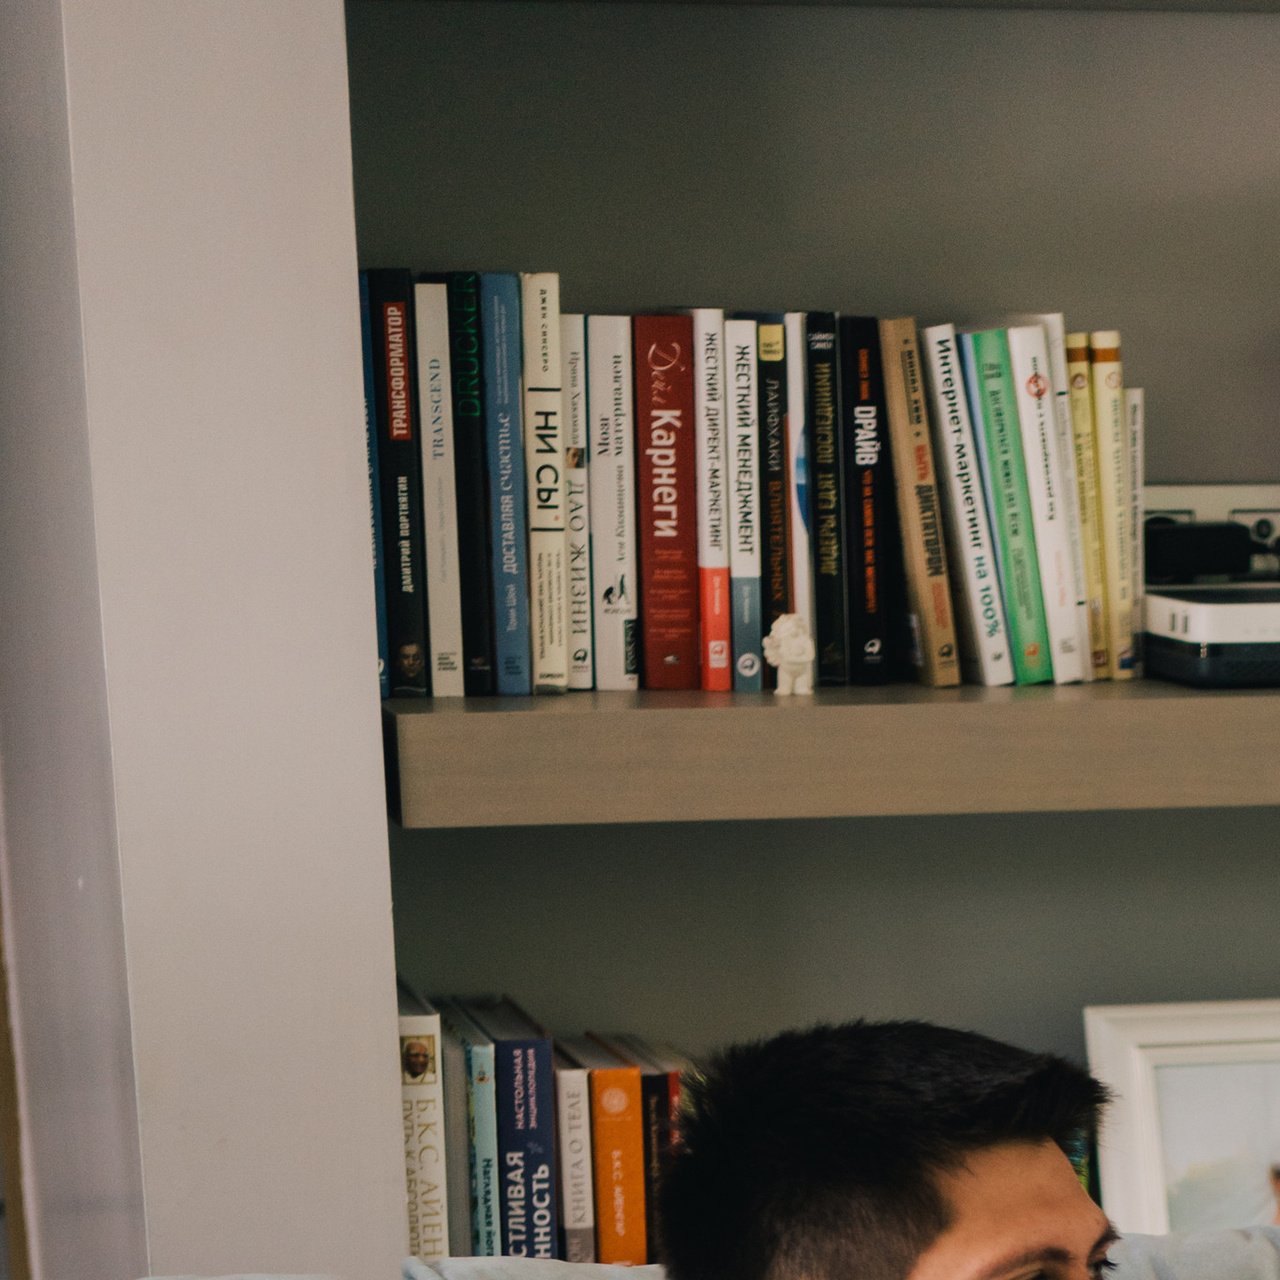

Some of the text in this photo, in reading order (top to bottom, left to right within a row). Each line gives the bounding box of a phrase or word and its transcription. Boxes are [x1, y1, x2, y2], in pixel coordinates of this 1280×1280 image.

[387, 307, 407, 435] ТРАНСФОРМАТОР
[453, 274, 480, 416] DRUCKER
[539, 288, 549, 373] ДЖЕН СИНСЕРО
[428, 358, 444, 460] TRANSCEND
[568, 351, 582, 446] Ирина Хакамада
[597, 415, 610, 456] Мозг
[612, 355, 626, 457] материален
[705, 332, 724, 551] ЖЕСТКИЙ ДИРЕКТ-МАРКЕТИНГ
[766, 378, 783, 471] ЛАЙФХАКИ
[495, 412, 513, 491] счастье
[534, 411, 559, 510] НИ СЫ
[645, 409, 682, 538] Карнеги
[735, 345, 756, 554] ЖЕСТКИЙ МЕНЕДЖМЕНТ
[814, 362, 839, 575] ЛИДЕРЫ ЕДЯТ ПОСЛЕДНИМИ
[936, 339, 1000, 638] Интернет-маркетинг на 100%
[397, 476, 414, 593] ДМИТРИЙ ПОРТНЯГИН
[500, 494, 518, 574] ДОСТАВЛЯЯ
[566, 480, 586, 635] ДАО ЖИЗНИ
[768, 480, 787, 600] ВЛИЯТЕЛЬНЫХ
[914, 484, 945, 577] ДИКТАТОРОМ
[403, 1100, 414, 1145] ПУТЬ
[416, 1098, 439, 1170] Б.К.С.
[513, 1049, 525, 1129] НАСТОЛЬНАЯ
[527, 1048, 537, 1129] ЭНЦИКЛОПЕДИЯ
[566, 1090, 582, 1134] ТЕЛЕ
[482, 1158, 493, 1227] Наглядная
[569, 1140, 583, 1153] О
[570, 1157, 586, 1224] КНИГА
